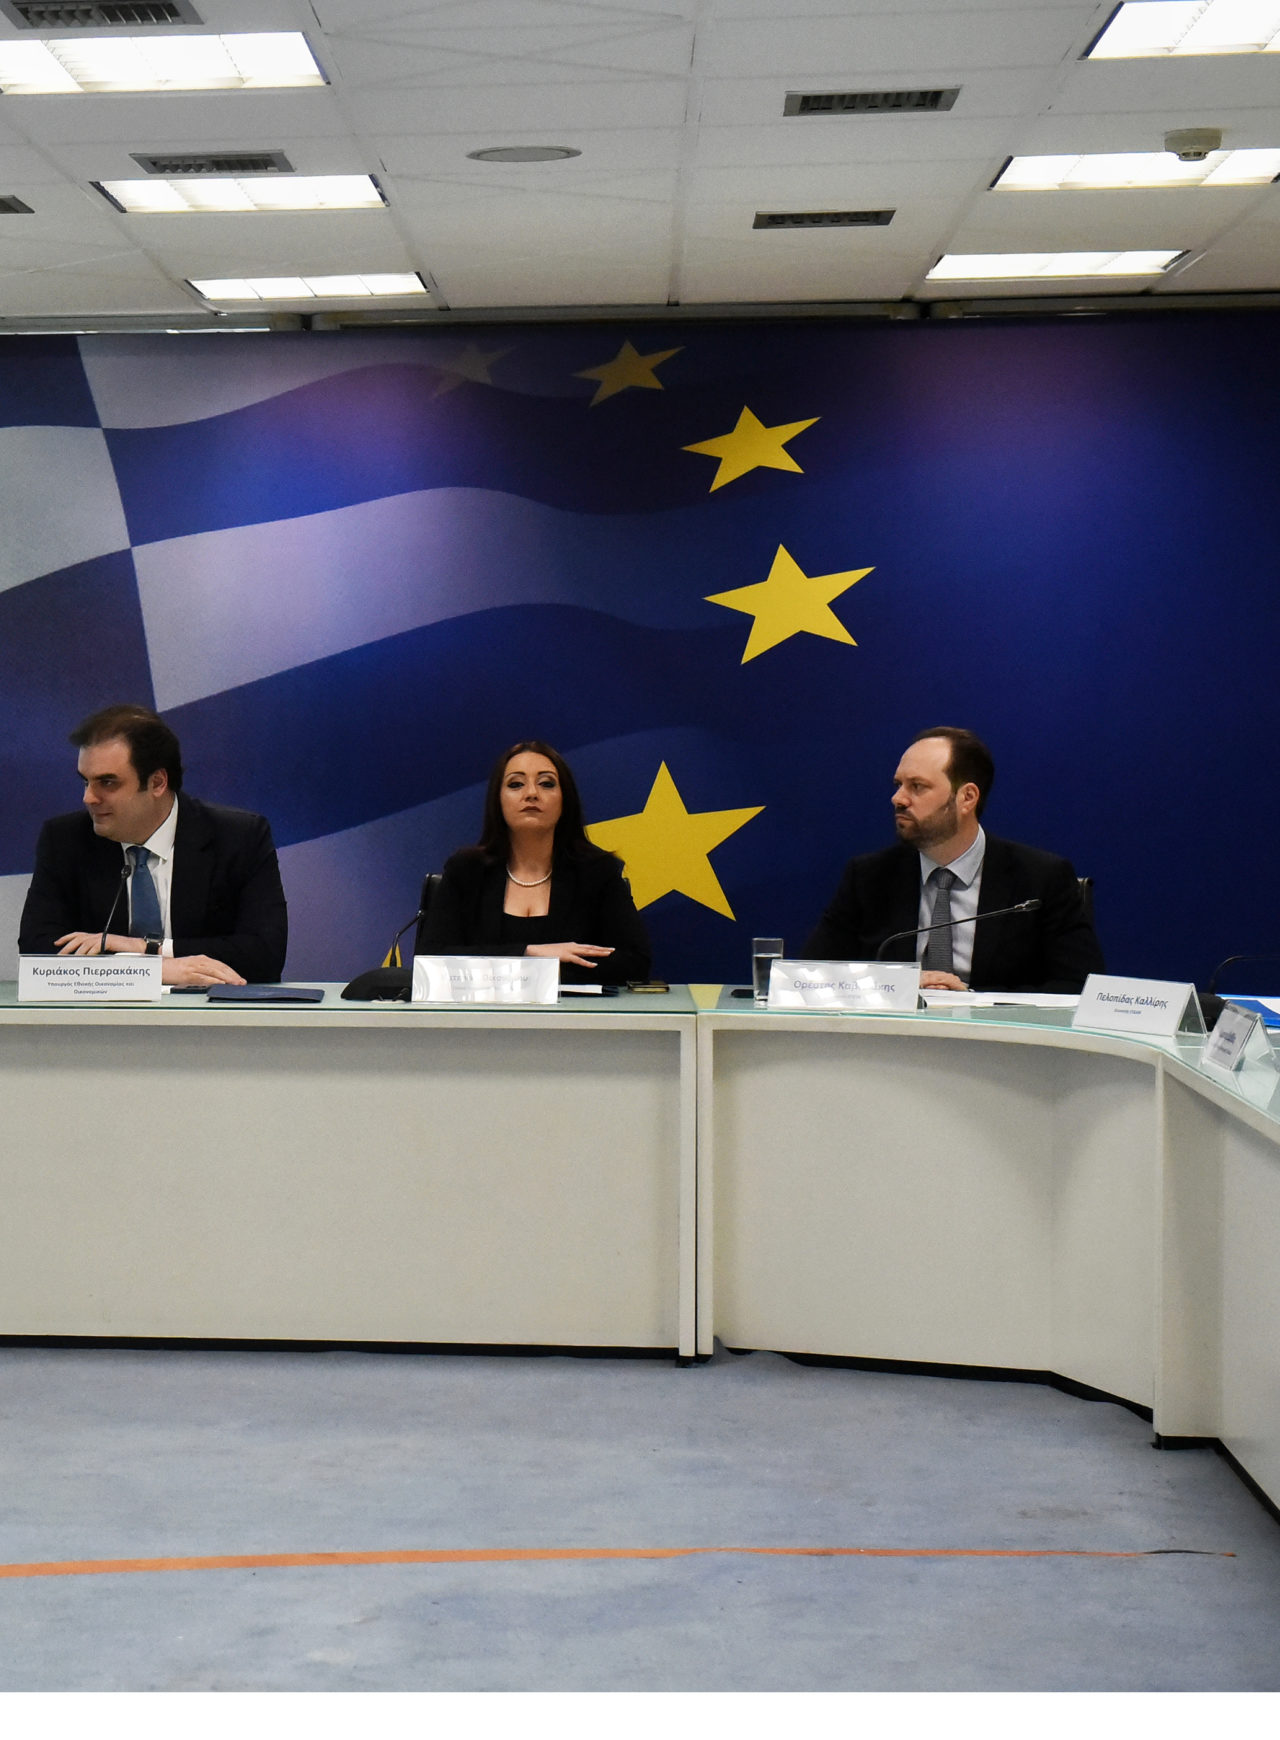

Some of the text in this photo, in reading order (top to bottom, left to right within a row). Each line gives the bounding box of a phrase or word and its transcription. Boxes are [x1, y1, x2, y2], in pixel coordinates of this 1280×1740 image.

[32, 966, 151, 977] Κυριάκος Πιερρακάκης
[1096, 992, 1169, 1010] Πελοπίδας Καλλίρης
